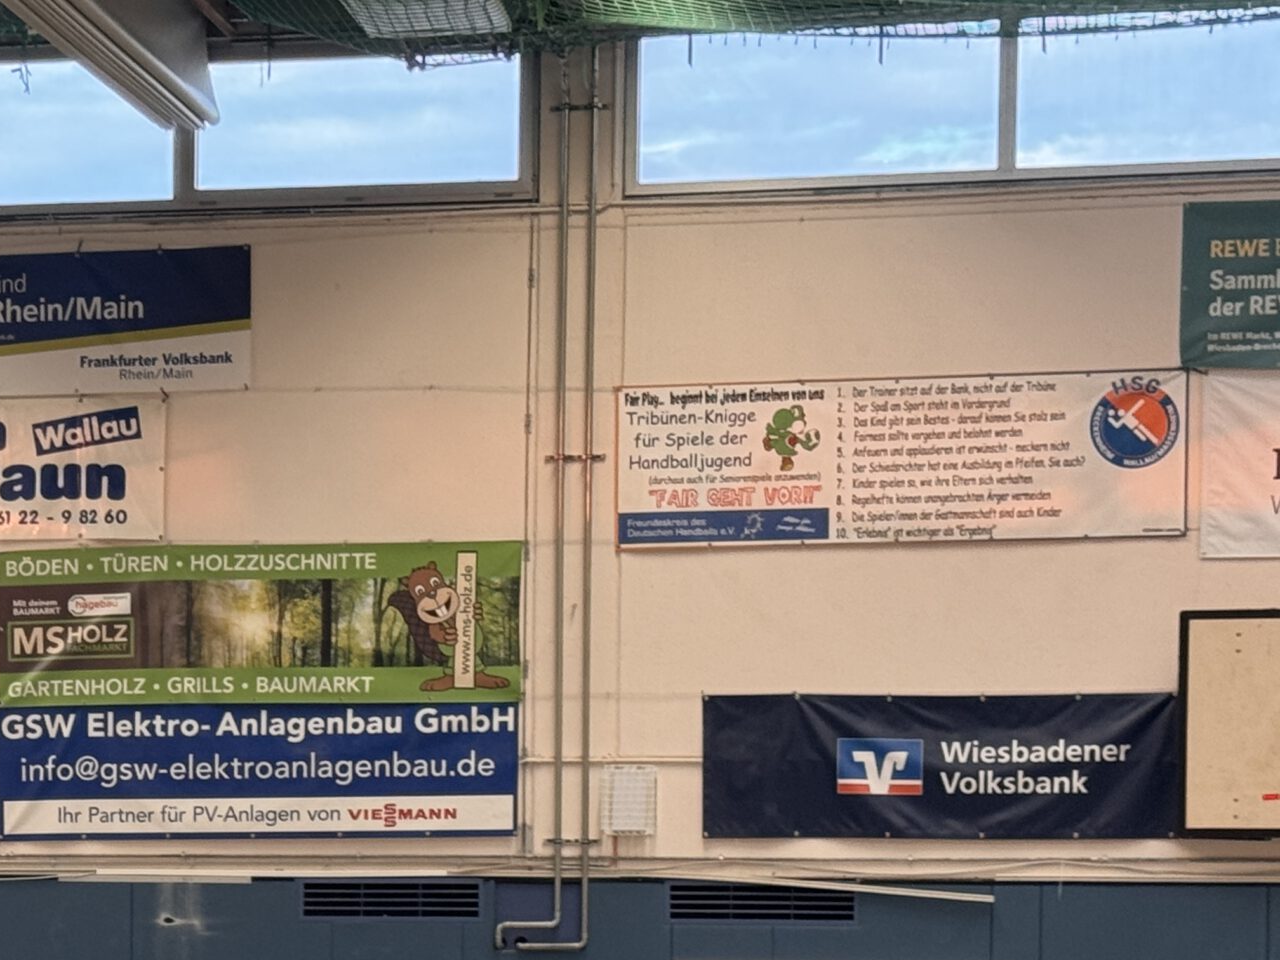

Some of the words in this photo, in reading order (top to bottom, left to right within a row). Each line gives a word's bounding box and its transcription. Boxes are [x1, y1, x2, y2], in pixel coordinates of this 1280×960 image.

[1210, 239, 1270, 258] REWE
[1208, 296, 1245, 317] der
[80, 353, 158, 368] Frankfurter
[162, 351, 233, 366] Volksbank
[119, 367, 193, 380] Rhein/Main
[836, 386, 846, 398] 1.
[852, 386, 868, 398] Der
[1111, 376, 1161, 395] HSG
[670, 390, 703, 409] beginnt
[705, 388, 718, 404] bei
[836, 402, 846, 413] 2.
[853, 402, 868, 413] Der
[626, 408, 757, 428] Tribünen-Knigge
[34, 415, 138, 451] Wallau
[634, 433, 659, 449] für
[665, 431, 714, 451] Spiele
[719, 431, 748, 446] der
[629, 452, 753, 473] Handballjugend
[707, 486, 756, 507] GEHT
[18, 510, 40, 525] 22
[62, 510, 71, 525] 9
[78, 510, 99, 524] 82
[104, 509, 128, 524] 60
[627, 518, 688, 528] Freundeskreis
[690, 517, 707, 526] des
[627, 527, 673, 538] Deutschen
[5, 556, 79, 577] BÖDEN
[100, 553, 168, 574] TÜREN
[190, 552, 377, 573] HOLZZUSCHNITTE
[13, 606, 61, 616] BAUMARKT
[75, 600, 119, 611] hagebau
[460, 565, 474, 675] www.ms-holz.de
[8, 677, 146, 699] GARTENHOLZ
[166, 676, 235, 695] GRILLS
[255, 675, 375, 695] BAUMARKT
[1, 713, 76, 739] GSW
[87, 710, 210, 738] Elektro-
[216, 708, 402, 743] Anlagenbau
[414, 706, 515, 734] GmbH
[941, 739, 1132, 764] Wiesbadener
[20, 750, 496, 788] info@gsw-elektroanlagenbau.de
[940, 770, 1088, 796] Volksbank
[57, 807, 82, 824] Ihr
[88, 806, 155, 823] Partner
[160, 804, 187, 823] für
[192, 803, 301, 826] PV-Anlagen
[307, 808, 341, 822] von
[347, 803, 457, 828] VIESSMANN
